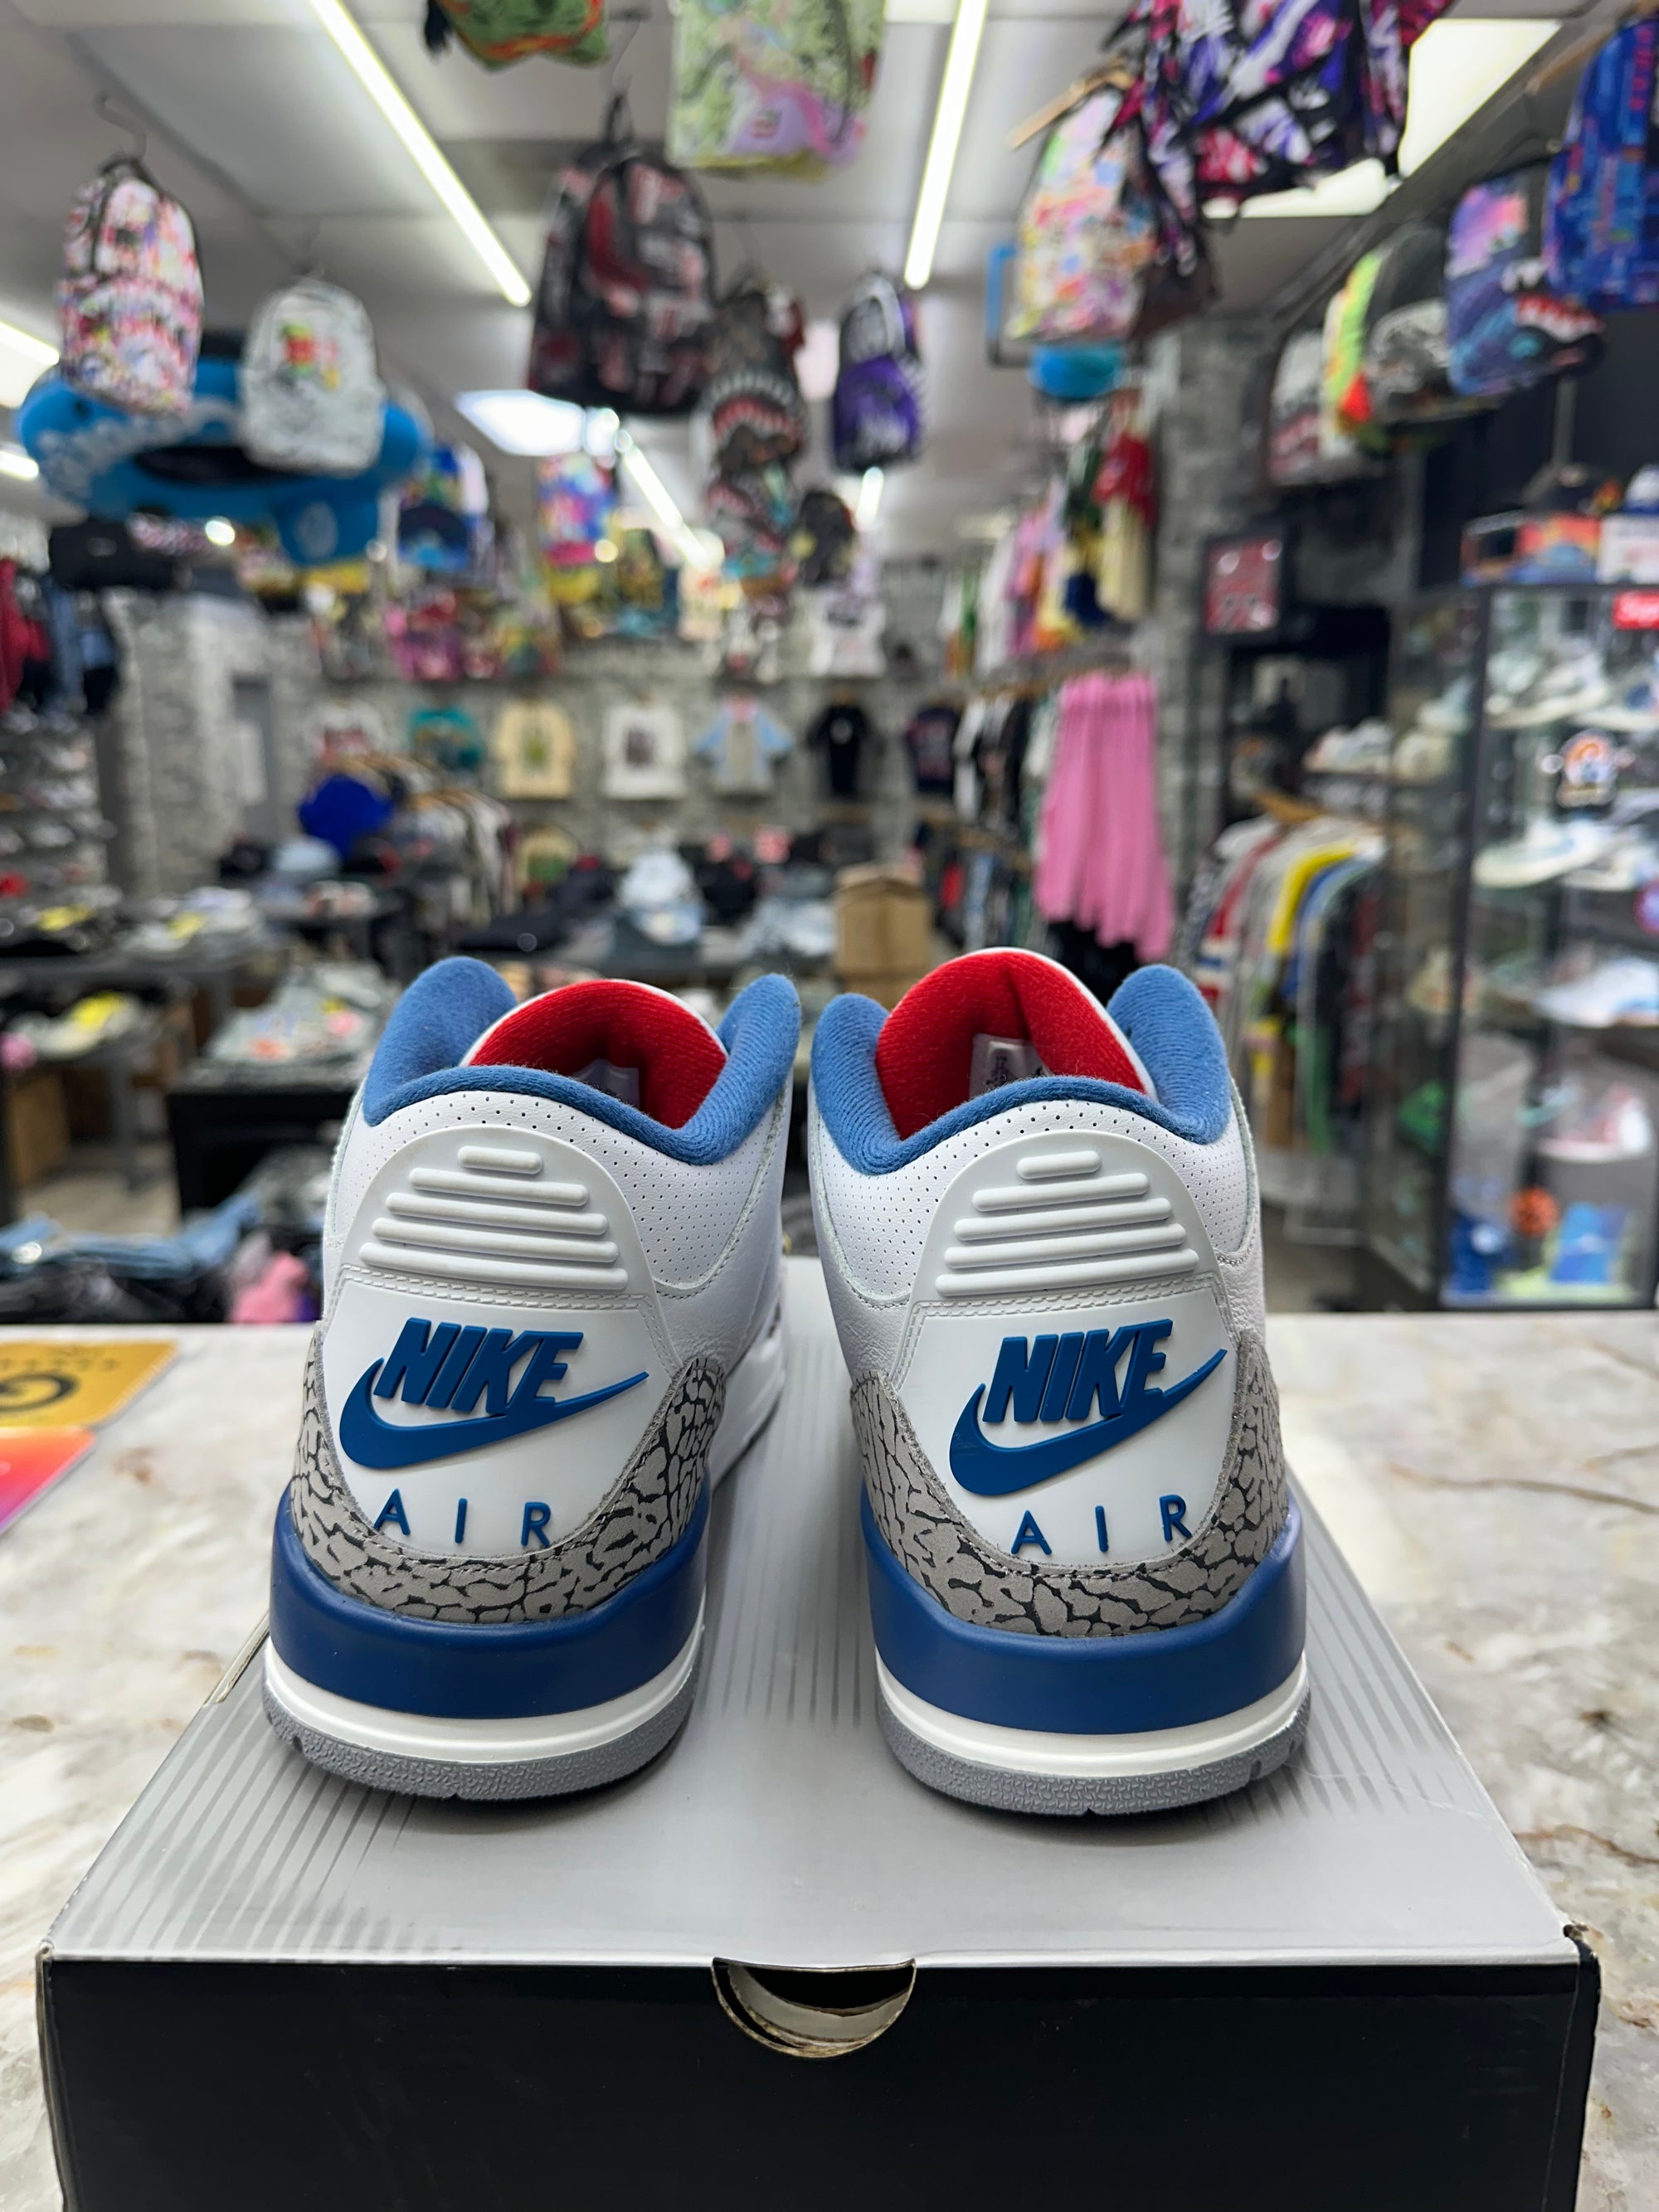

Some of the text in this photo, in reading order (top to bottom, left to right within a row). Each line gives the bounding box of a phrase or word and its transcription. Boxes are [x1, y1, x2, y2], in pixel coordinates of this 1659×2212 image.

[373, 1317, 584, 1415] NIKE
[982, 1319, 1173, 1422] NIKE
[373, 1488, 552, 1547] AIR
[1010, 1495, 1193, 1555] AIR
